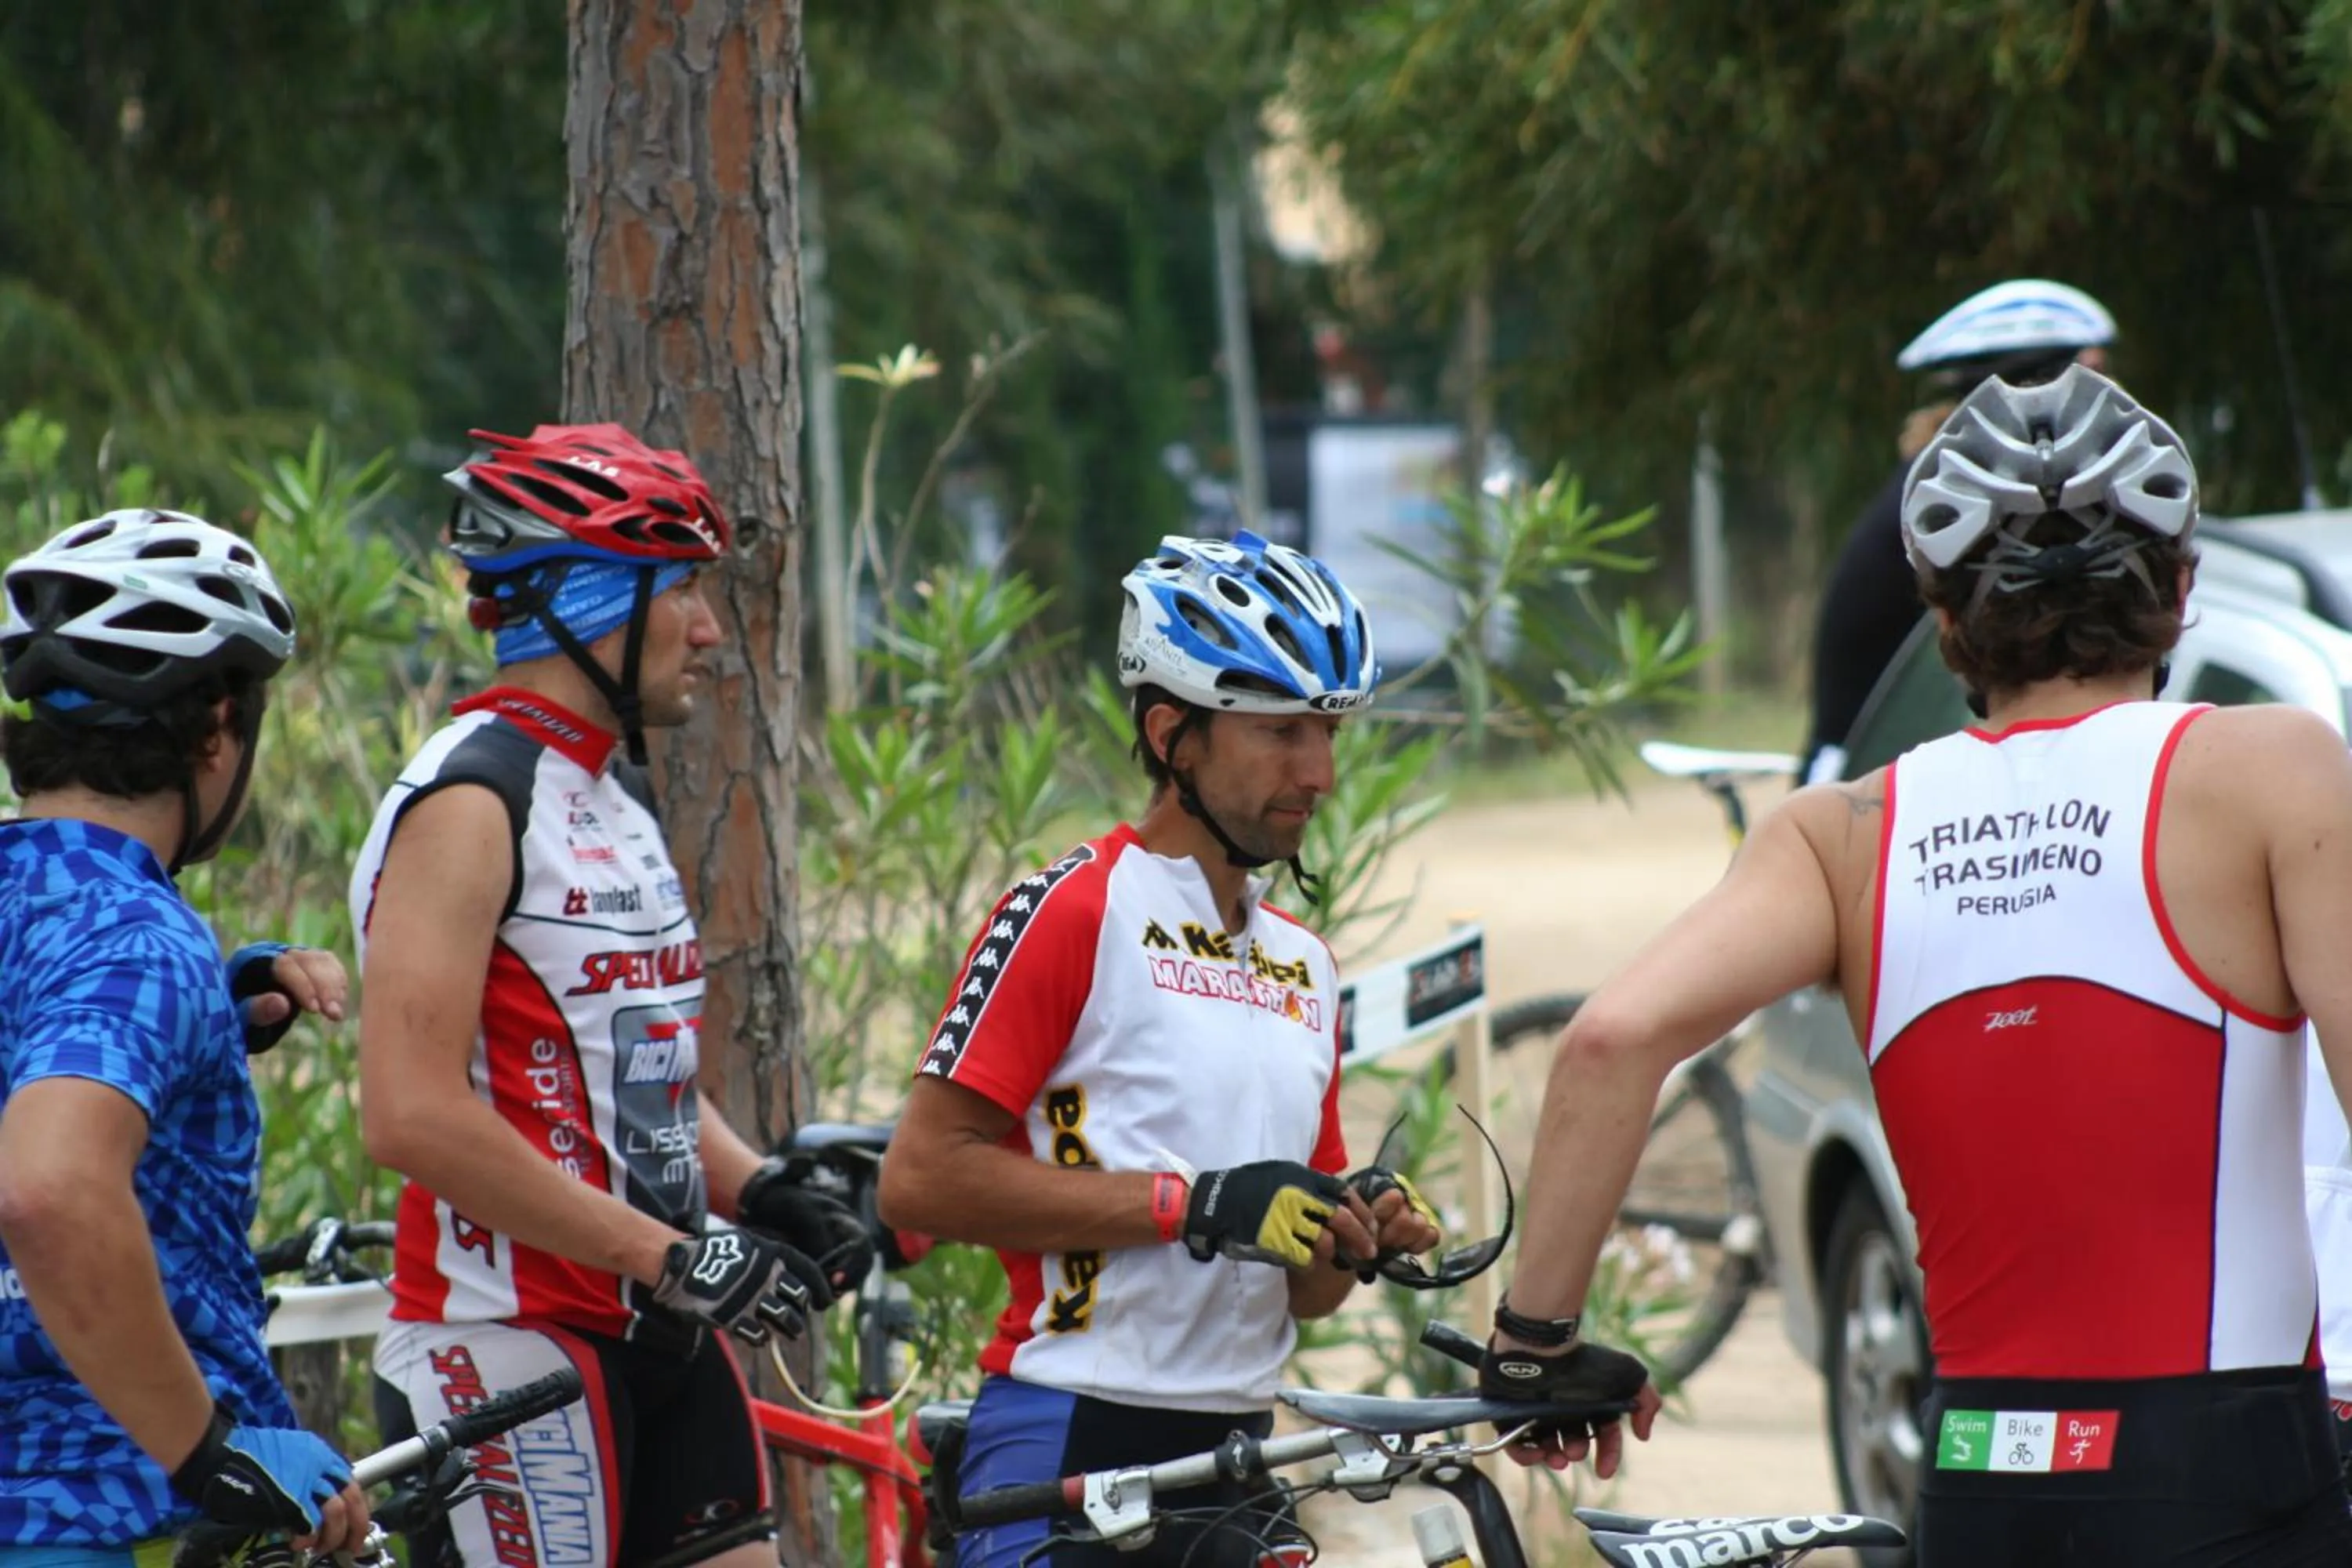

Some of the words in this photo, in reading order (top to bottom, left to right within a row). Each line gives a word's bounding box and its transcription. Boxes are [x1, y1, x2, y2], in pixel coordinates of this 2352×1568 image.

[1908, 799, 2111, 865] TRIATHLON
[1914, 844, 2103, 896] TRASIMENO
[1957, 884, 2057, 916] PERUGIA
[525, 1037, 580, 1179] seide
[1947, 1415, 1987, 1434] Swim
[2007, 1419, 2043, 1437] Bike
[2068, 1421, 2100, 1438] Run
[1620, 1514, 1864, 1568] marco
